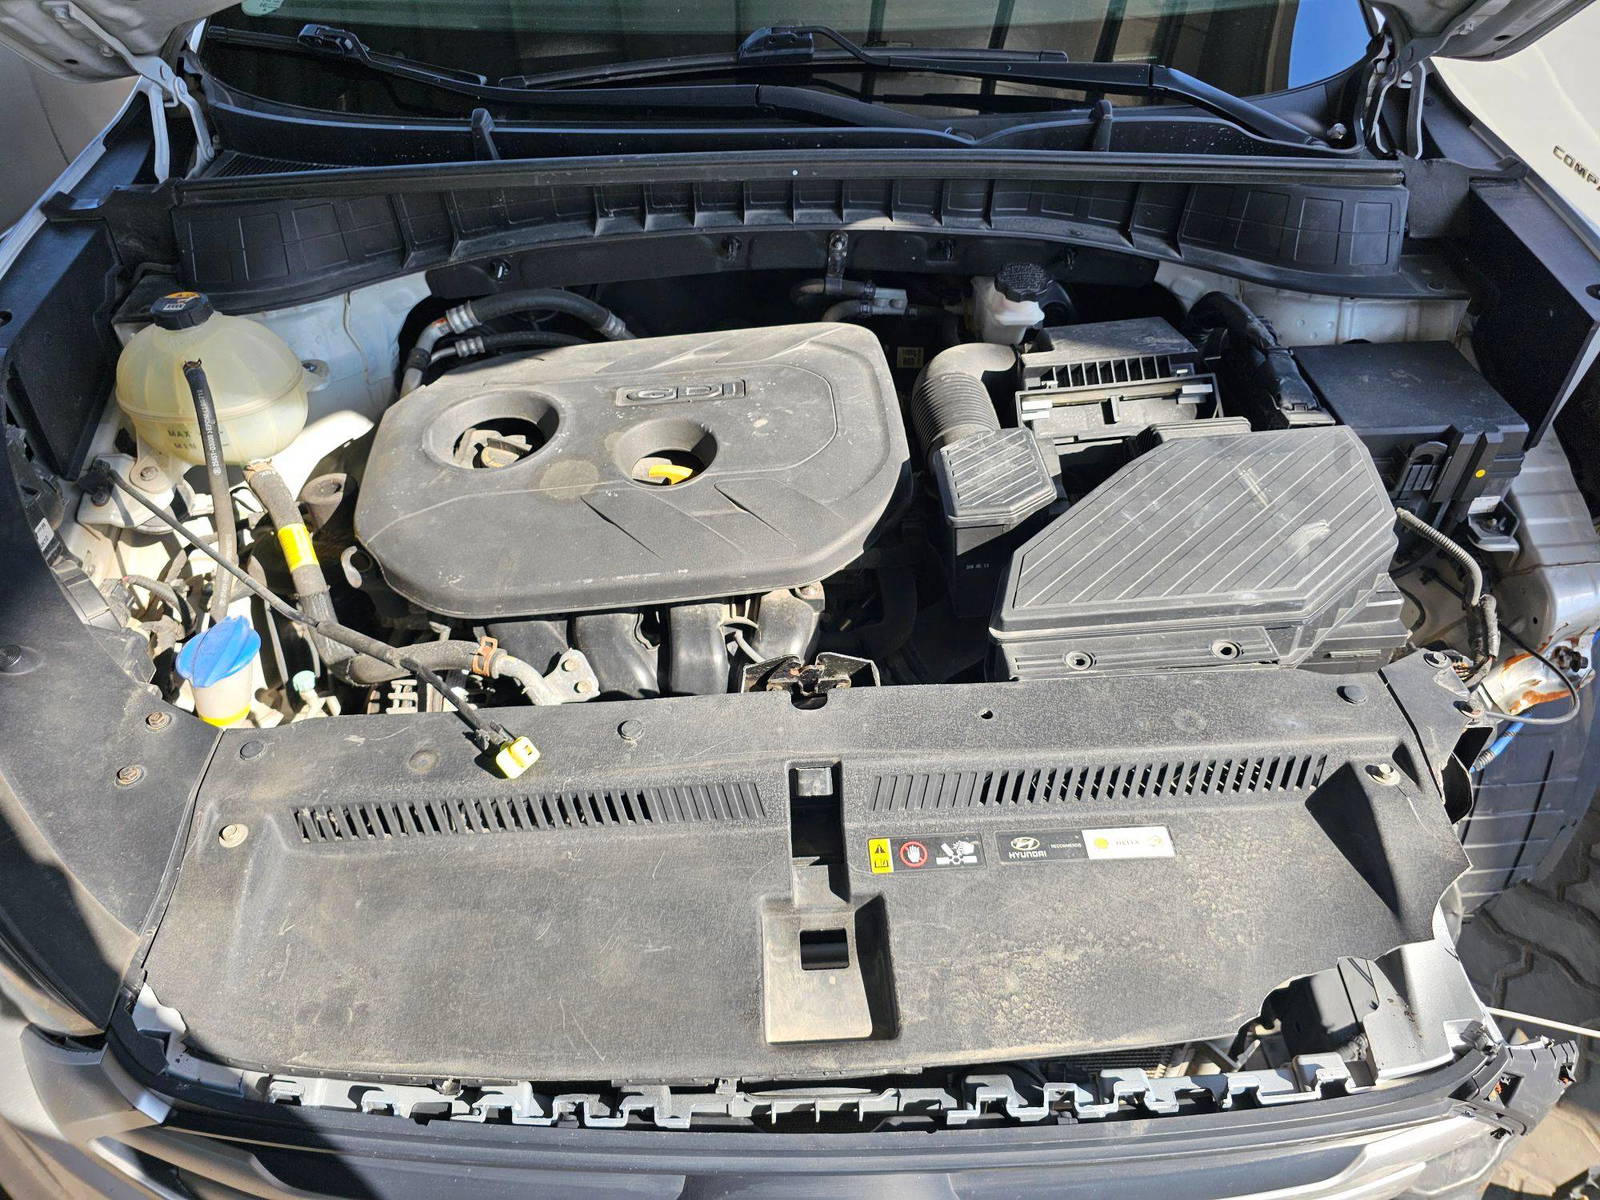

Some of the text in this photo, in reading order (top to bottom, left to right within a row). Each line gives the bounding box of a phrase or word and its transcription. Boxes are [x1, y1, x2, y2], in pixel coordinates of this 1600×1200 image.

[1553, 146, 1600, 191] COMP
[626, 383, 736, 400] GDI
[1008, 850, 1047, 859] HYUNDAI
